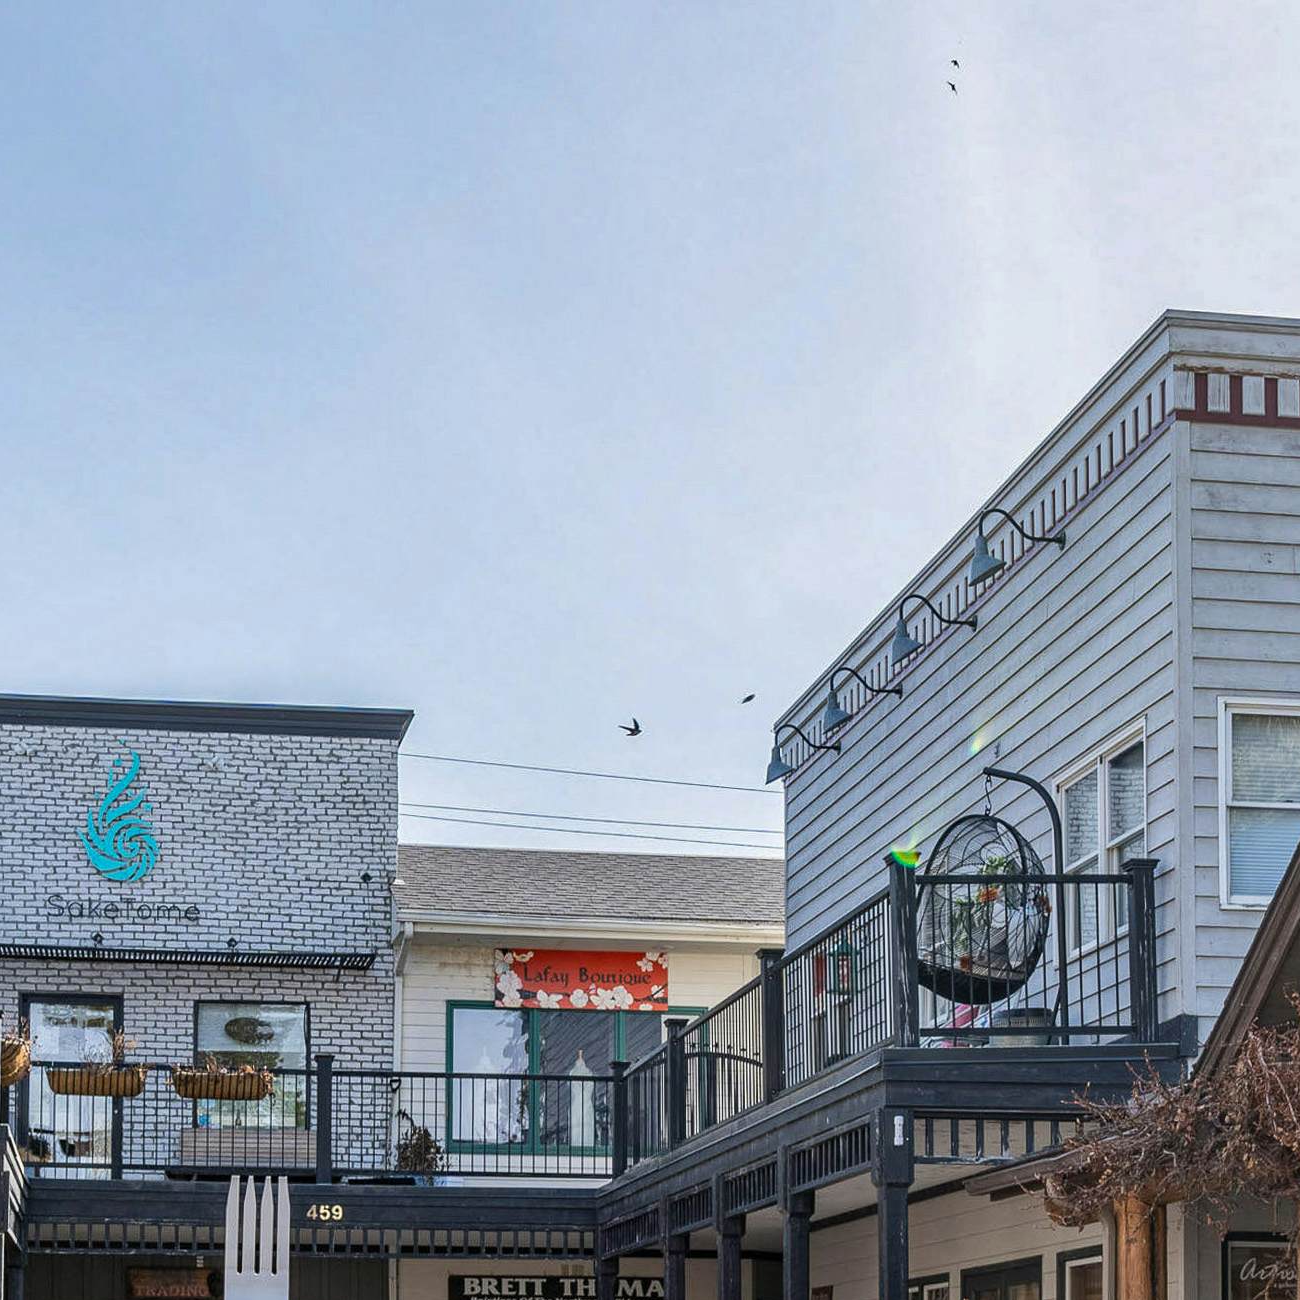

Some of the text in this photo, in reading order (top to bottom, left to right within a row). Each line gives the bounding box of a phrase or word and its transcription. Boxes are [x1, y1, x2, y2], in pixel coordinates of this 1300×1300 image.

[47, 894, 200, 921] SakeTome
[523, 963, 652, 986] Lafay Boutique
[306, 1204, 343, 1220] 459
[463, 1277, 547, 1296] BRETT
